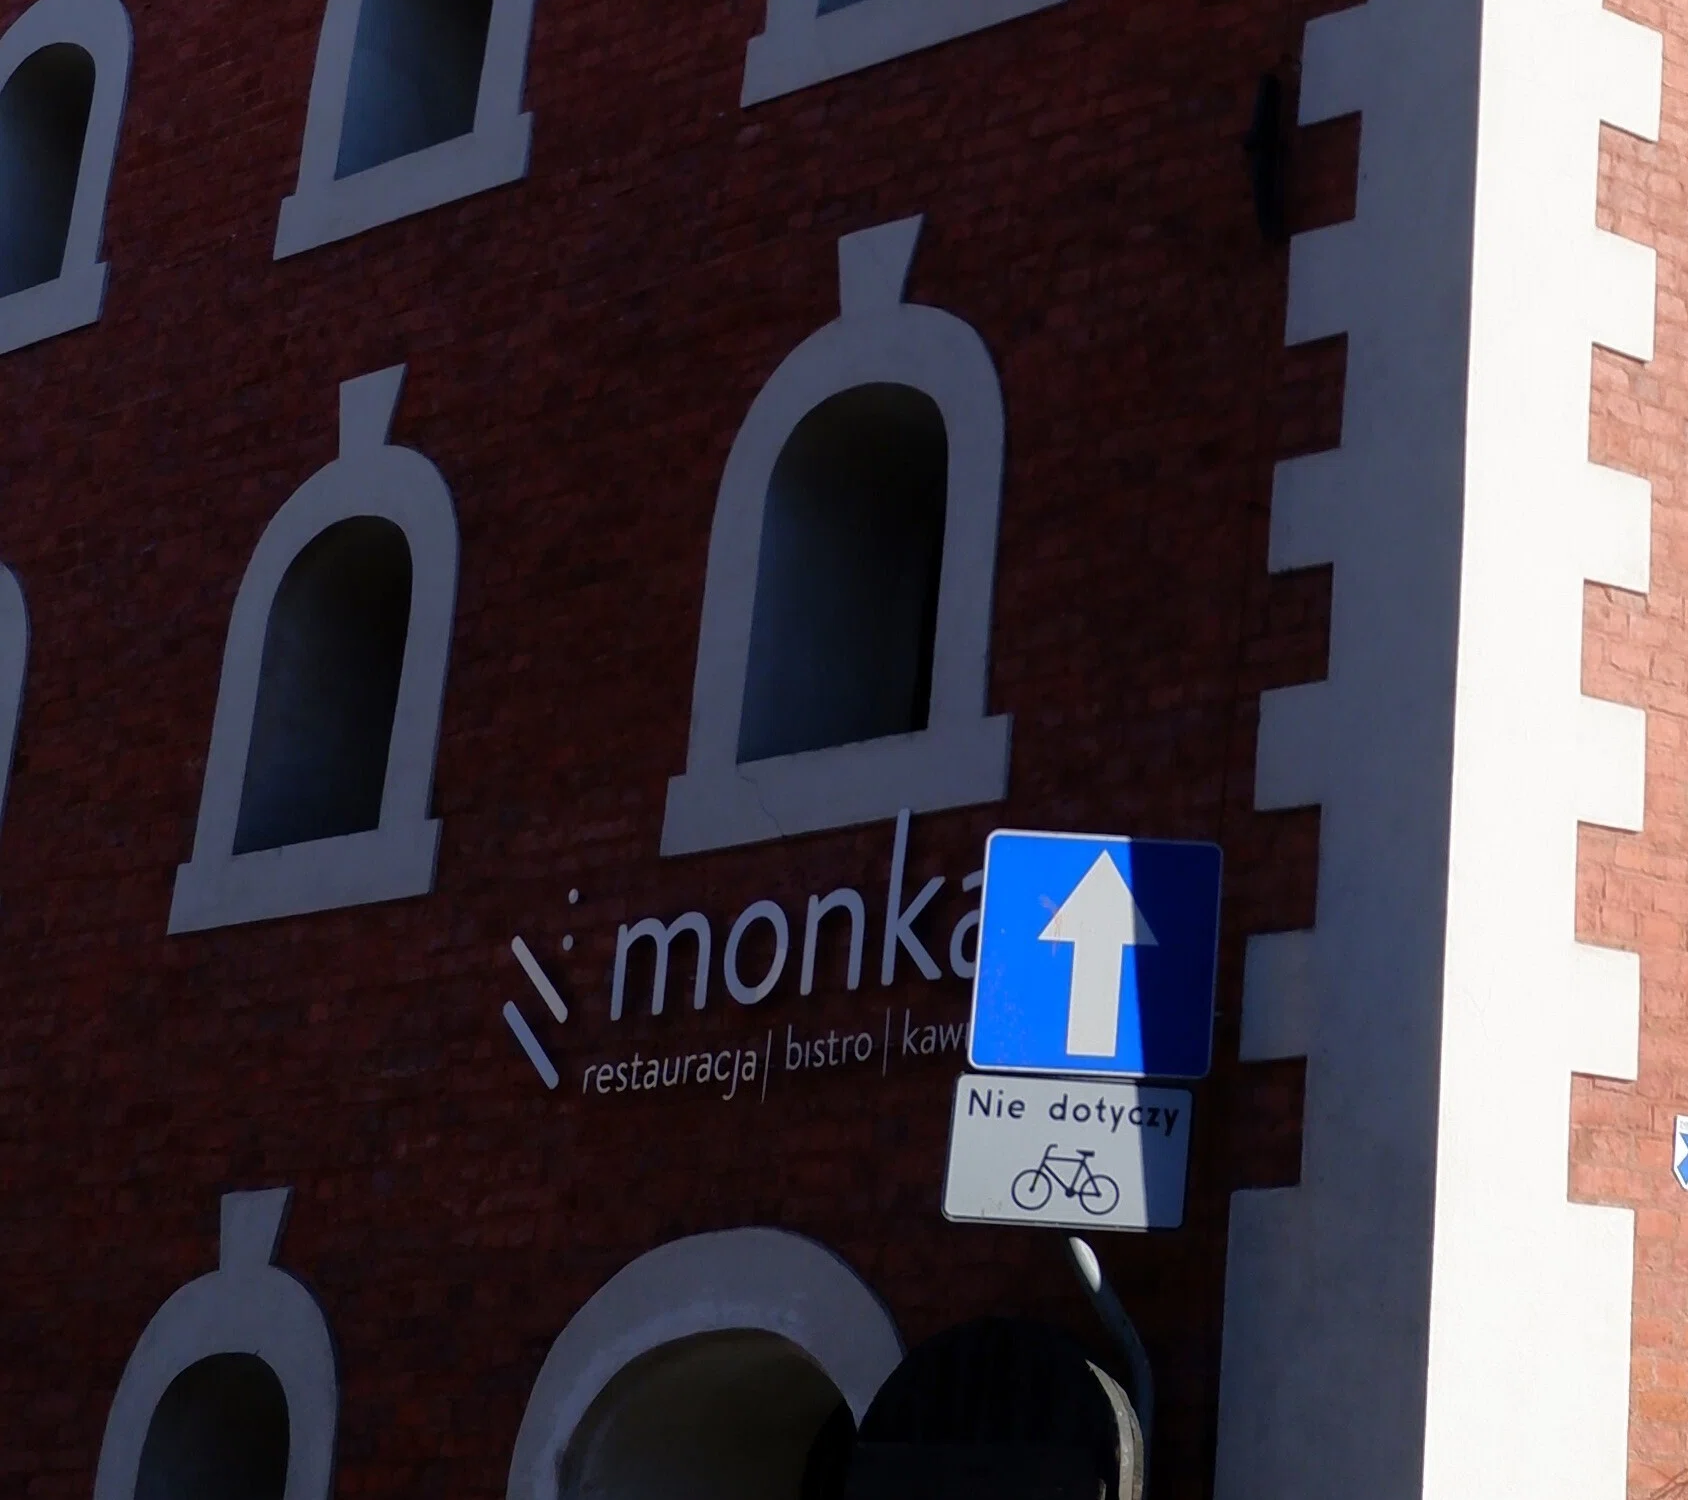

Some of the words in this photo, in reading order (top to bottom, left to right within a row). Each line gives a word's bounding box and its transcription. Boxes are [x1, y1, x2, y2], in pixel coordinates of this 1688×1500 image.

[582, 1047, 758, 1102] restauracja
[785, 1023, 874, 1071] bistro
[968, 1088, 1026, 1119] Nie
[1049, 1093, 1180, 1137] dotyczy
